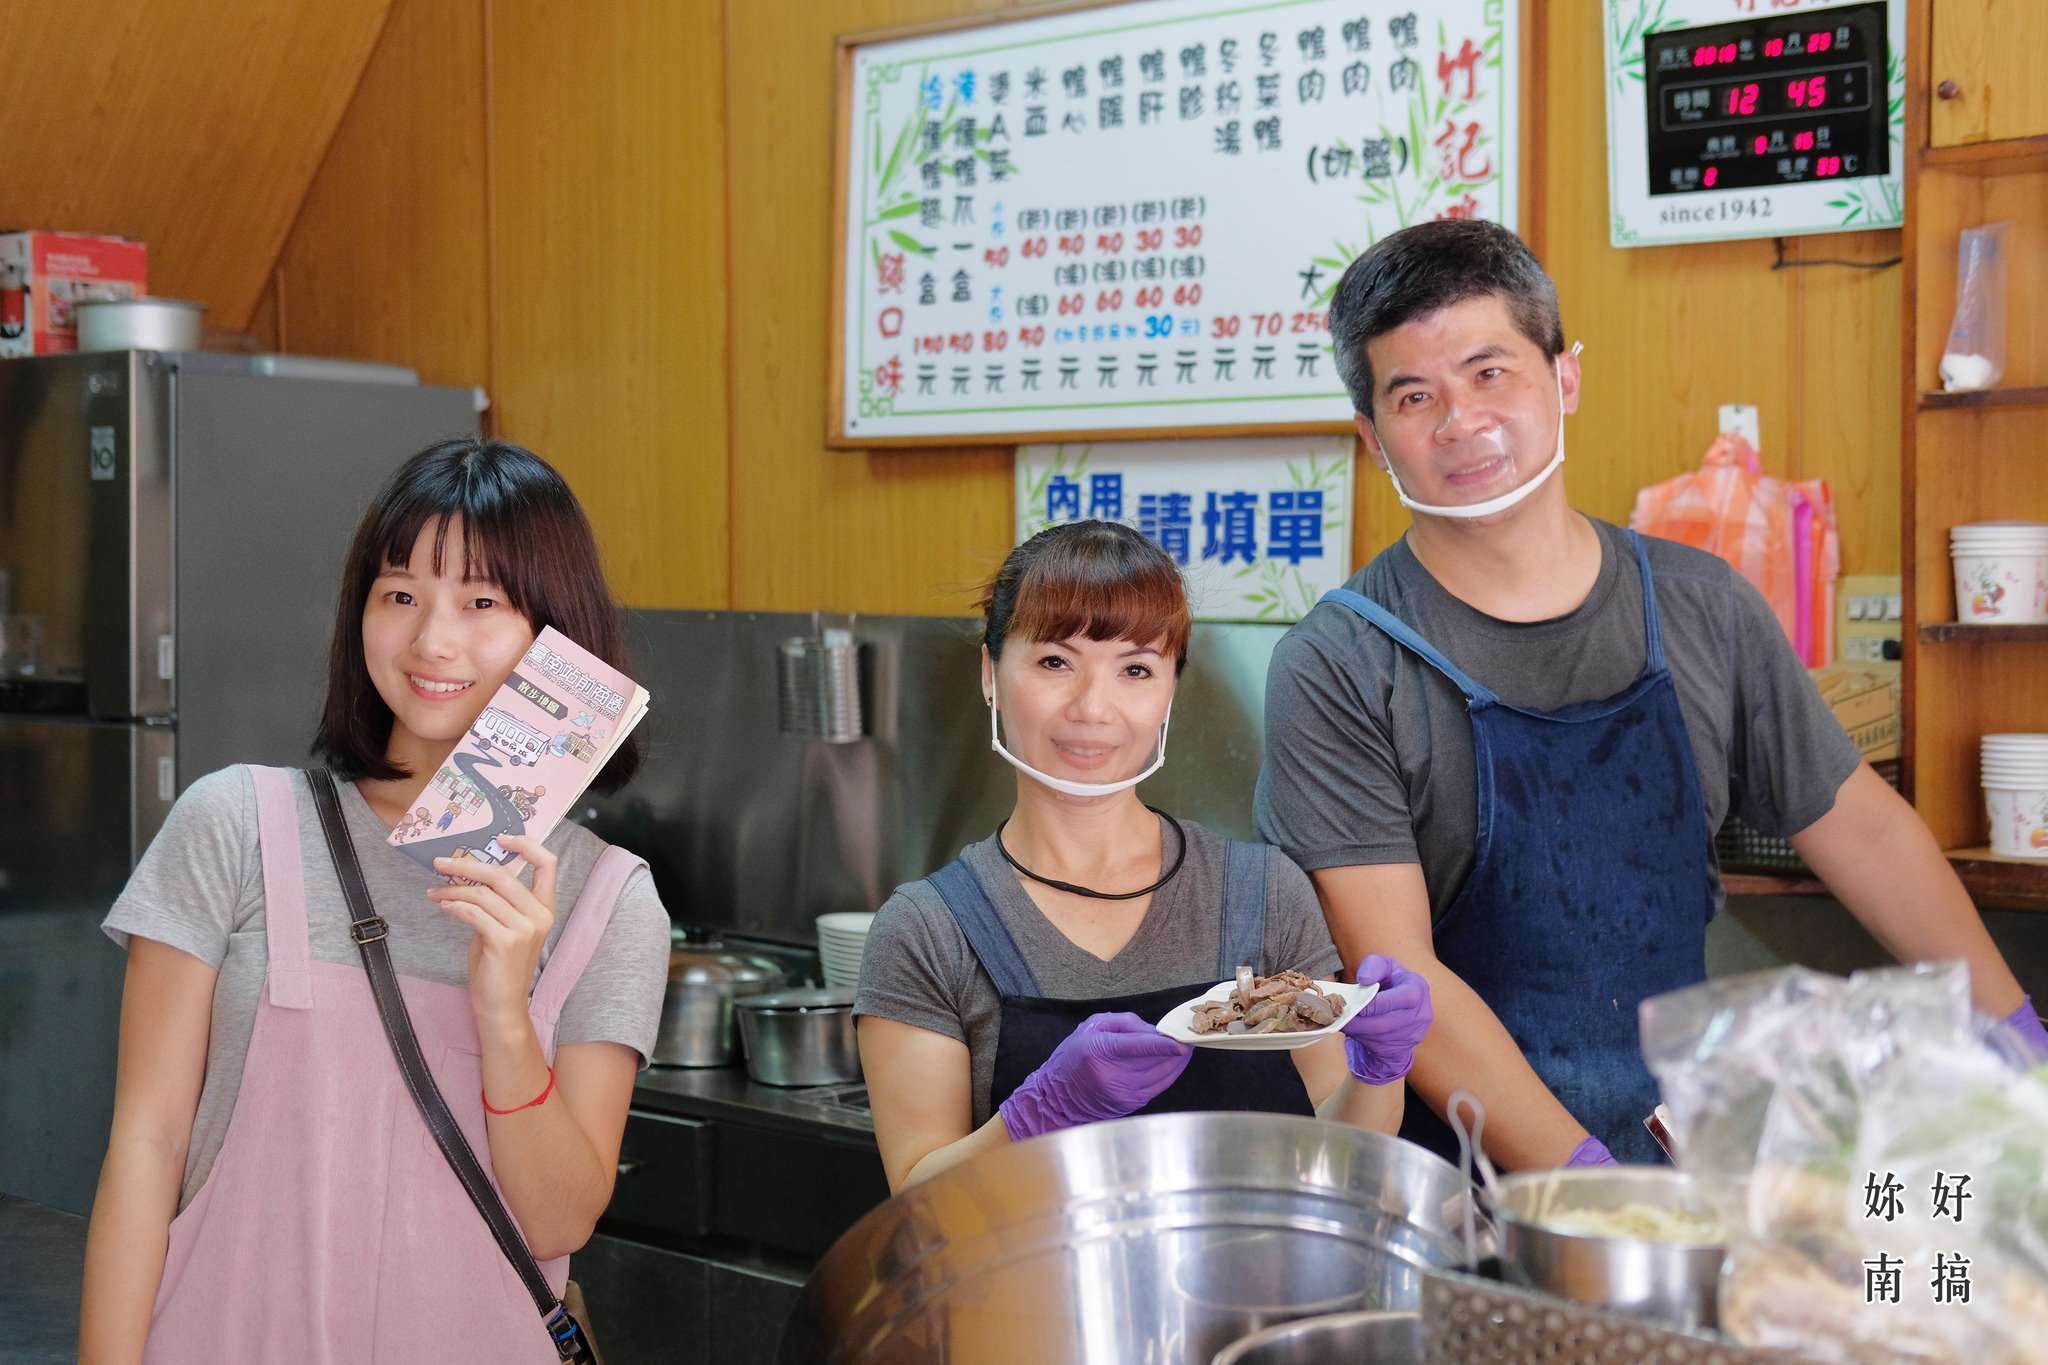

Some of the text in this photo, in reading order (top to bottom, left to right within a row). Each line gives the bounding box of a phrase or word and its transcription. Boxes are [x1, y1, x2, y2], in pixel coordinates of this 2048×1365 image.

[1728, 83, 1759, 115] 12
[1788, 76, 1826, 108] 45
[1659, 198, 1775, 223] since1942
[1137, 228, 1163, 252] 30
[1174, 224, 1202, 248] 30
[1212, 315, 1240, 338] 30
[1251, 312, 1283, 336] 70
[1021, 359, 1042, 391] 元
[1058, 357, 1080, 389] 元
[1097, 356, 1119, 388] 元
[1137, 354, 1158, 386] 元
[1176, 351, 1198, 384] 元
[1214, 348, 1236, 381] 元
[1252, 345, 1276, 379] 元
[1296, 343, 1320, 377] 元
[917, 364, 937, 396] 元
[951, 366, 972, 395] 元
[985, 365, 1005, 394] 元
[1047, 473, 1324, 566] 內用 請填單
